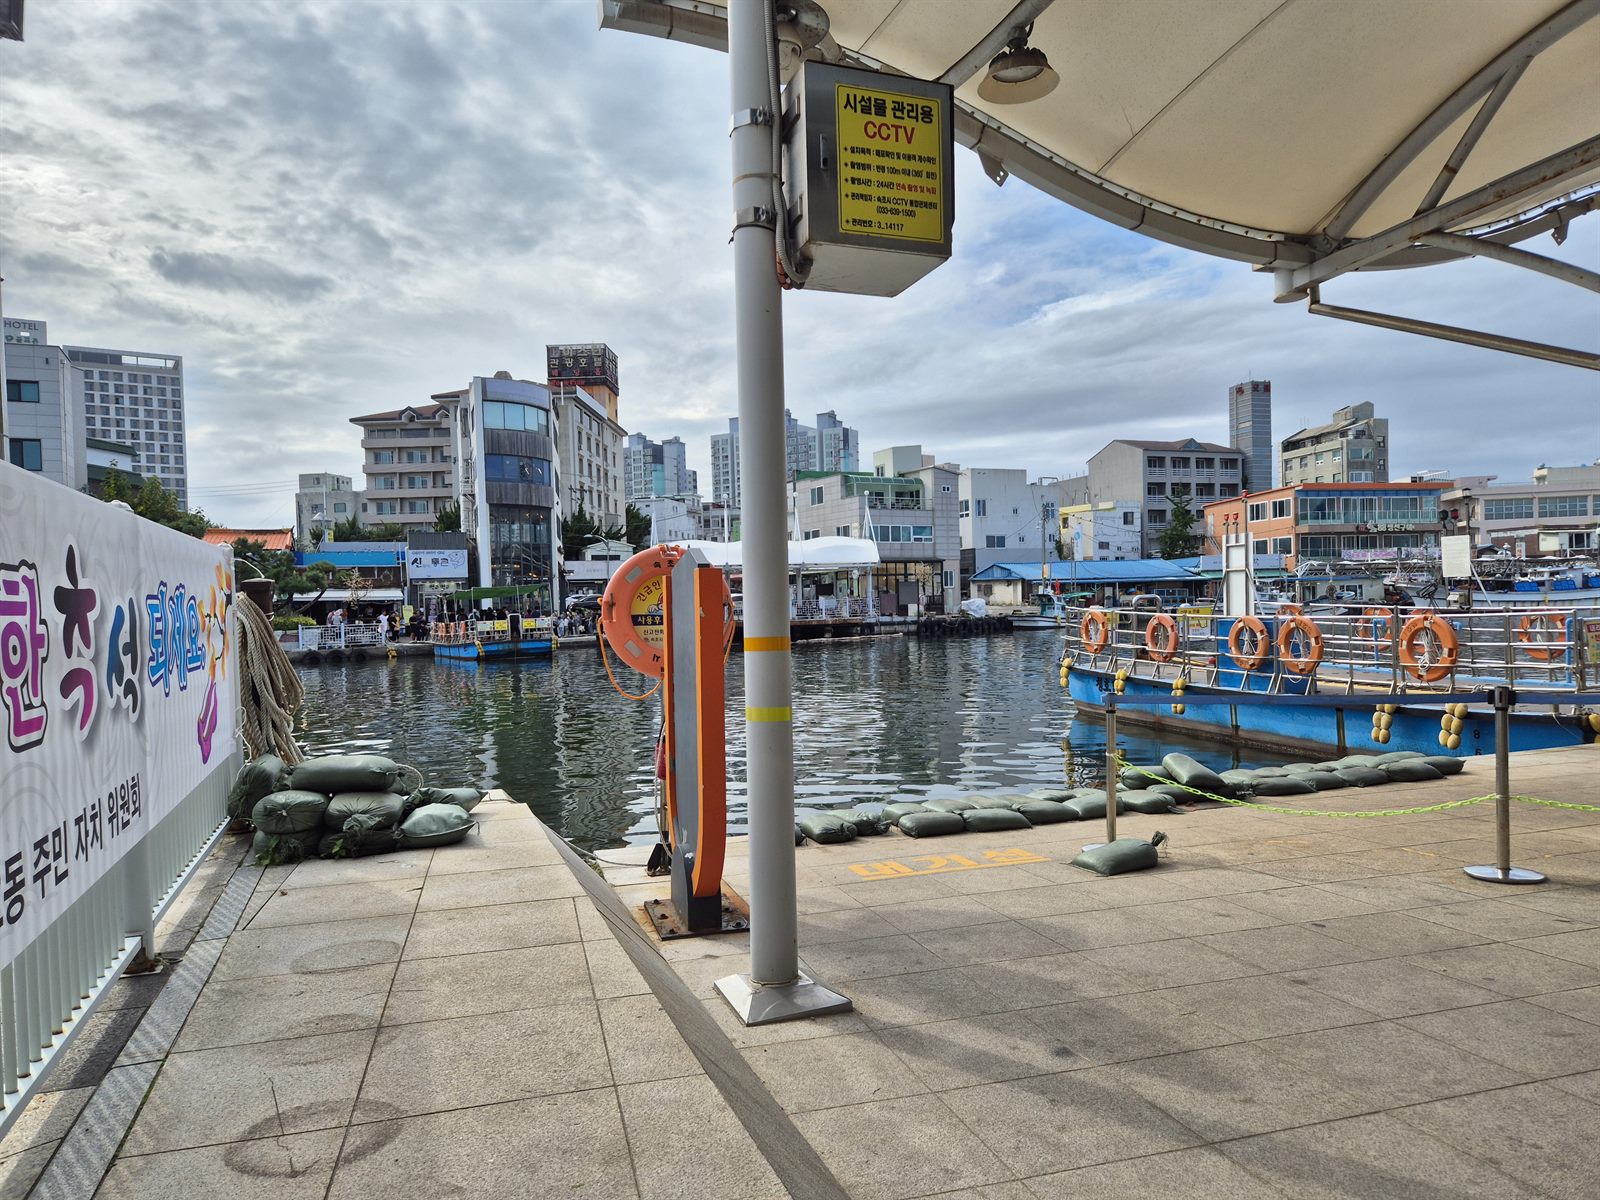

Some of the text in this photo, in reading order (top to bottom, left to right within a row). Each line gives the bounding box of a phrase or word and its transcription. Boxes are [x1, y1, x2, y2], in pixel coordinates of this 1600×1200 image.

[844, 93, 934, 124] 시설물 관리용
[864, 120, 916, 145] CCTV
[876, 180, 895, 190] 24시간
[877, 195, 892, 204] 속초시
[892, 197, 909, 207] CCTV
[851, 218, 874, 228] 관리번호
[4, 320, 39, 331] HOTEL
[638, 615, 662, 625] 사용후
[54, 544, 140, 733] 추석
[1473, 729, 1481, 740] 8
[0, 773, 142, 926] 동 주민 자치 위원회
